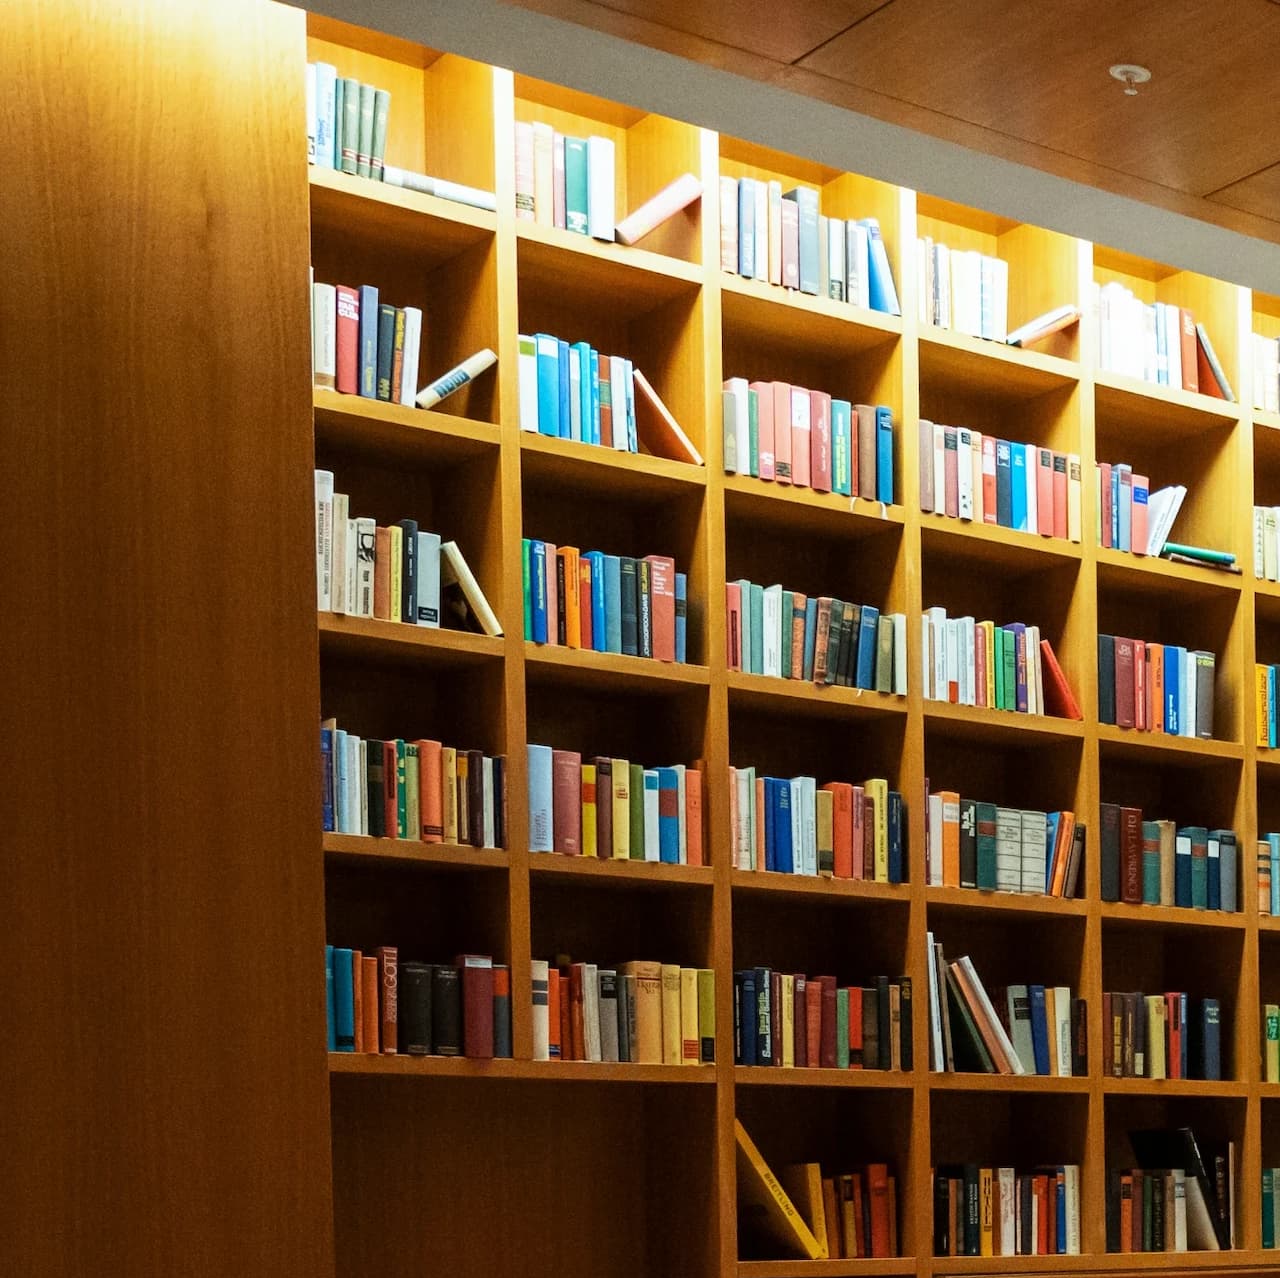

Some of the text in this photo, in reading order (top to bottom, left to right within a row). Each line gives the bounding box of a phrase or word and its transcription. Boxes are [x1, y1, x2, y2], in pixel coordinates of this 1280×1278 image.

[1127, 835, 1137, 895] LAWRENCE
[384, 950, 397, 988] GOTTI
[763, 1171, 795, 1217] BREITLING
